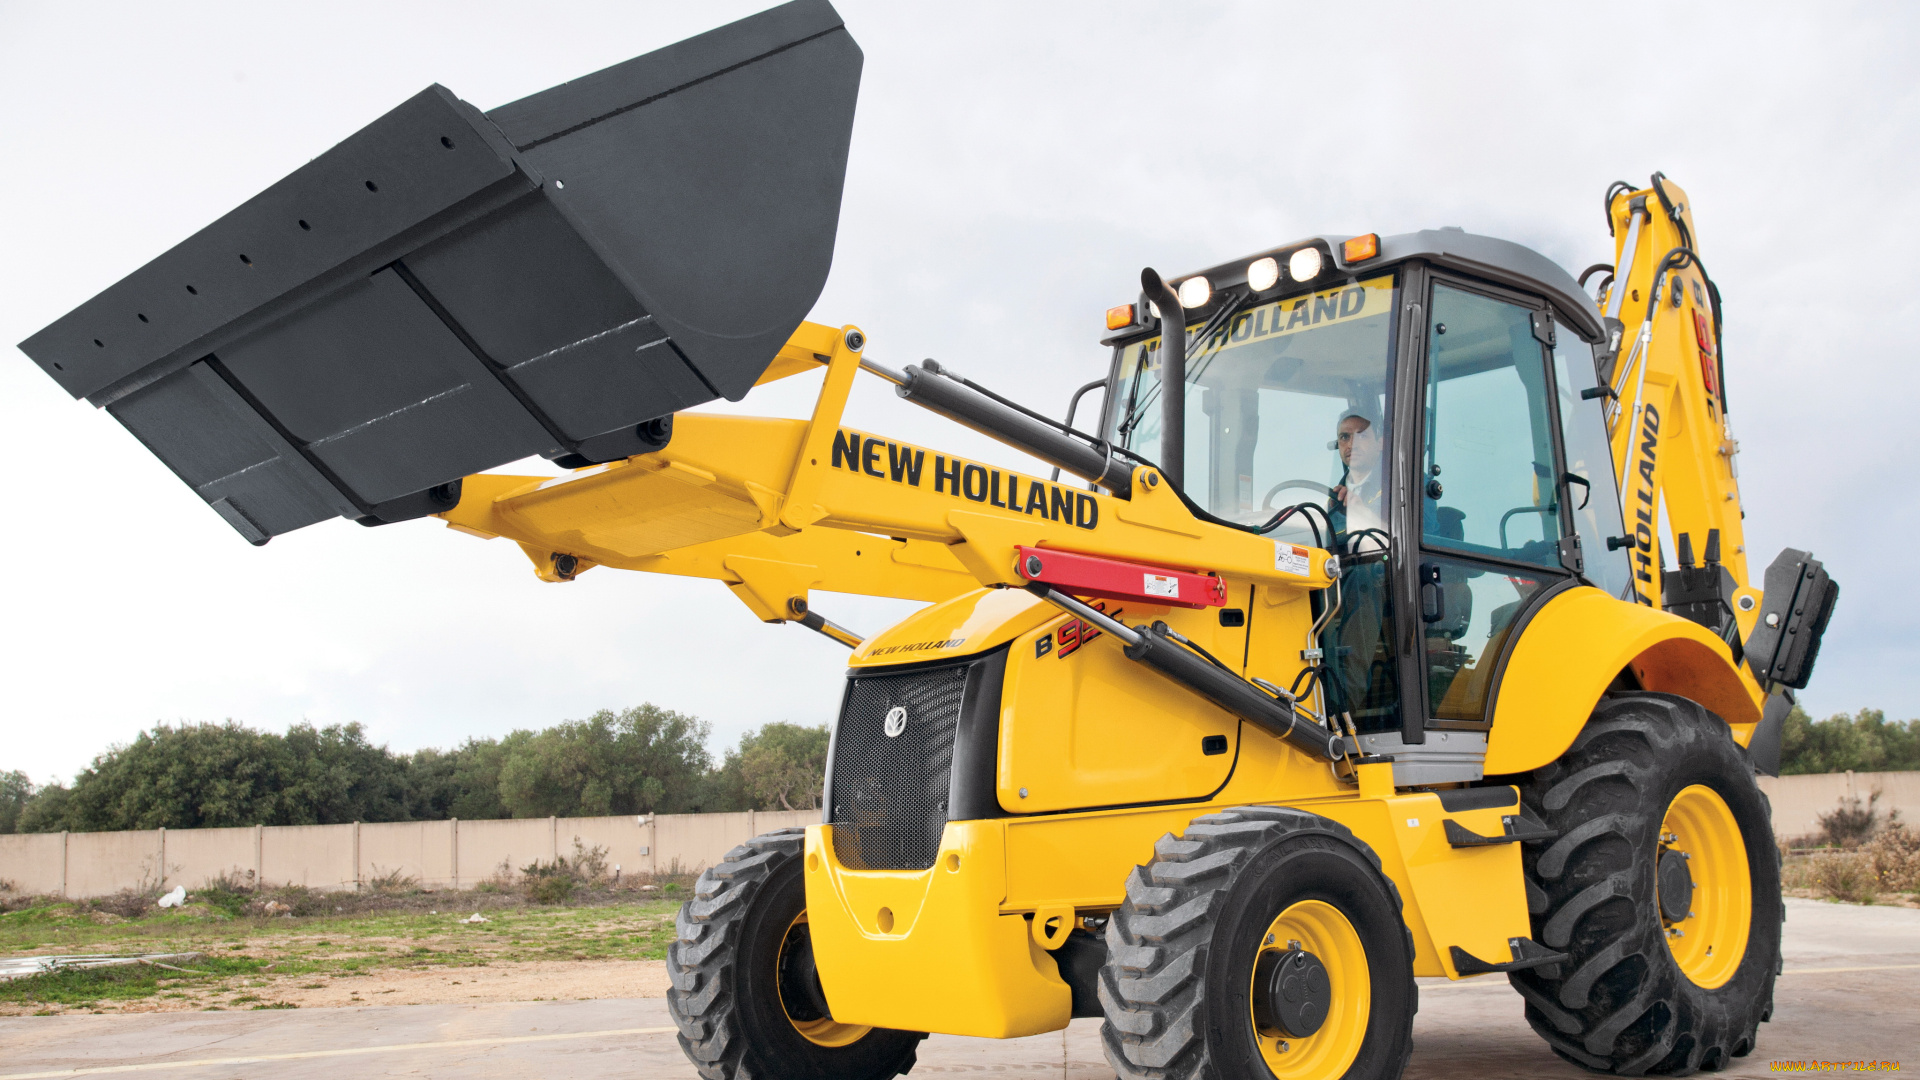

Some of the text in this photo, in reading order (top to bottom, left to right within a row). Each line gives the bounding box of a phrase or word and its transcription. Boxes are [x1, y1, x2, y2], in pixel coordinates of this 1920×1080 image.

[1207, 287, 1366, 350] HOLLAND
[831, 428, 1099, 531] NEW HOLLAND
[1636, 403, 1660, 584] HOLLAND
[867, 638, 966, 657] NEW HOLLAND
